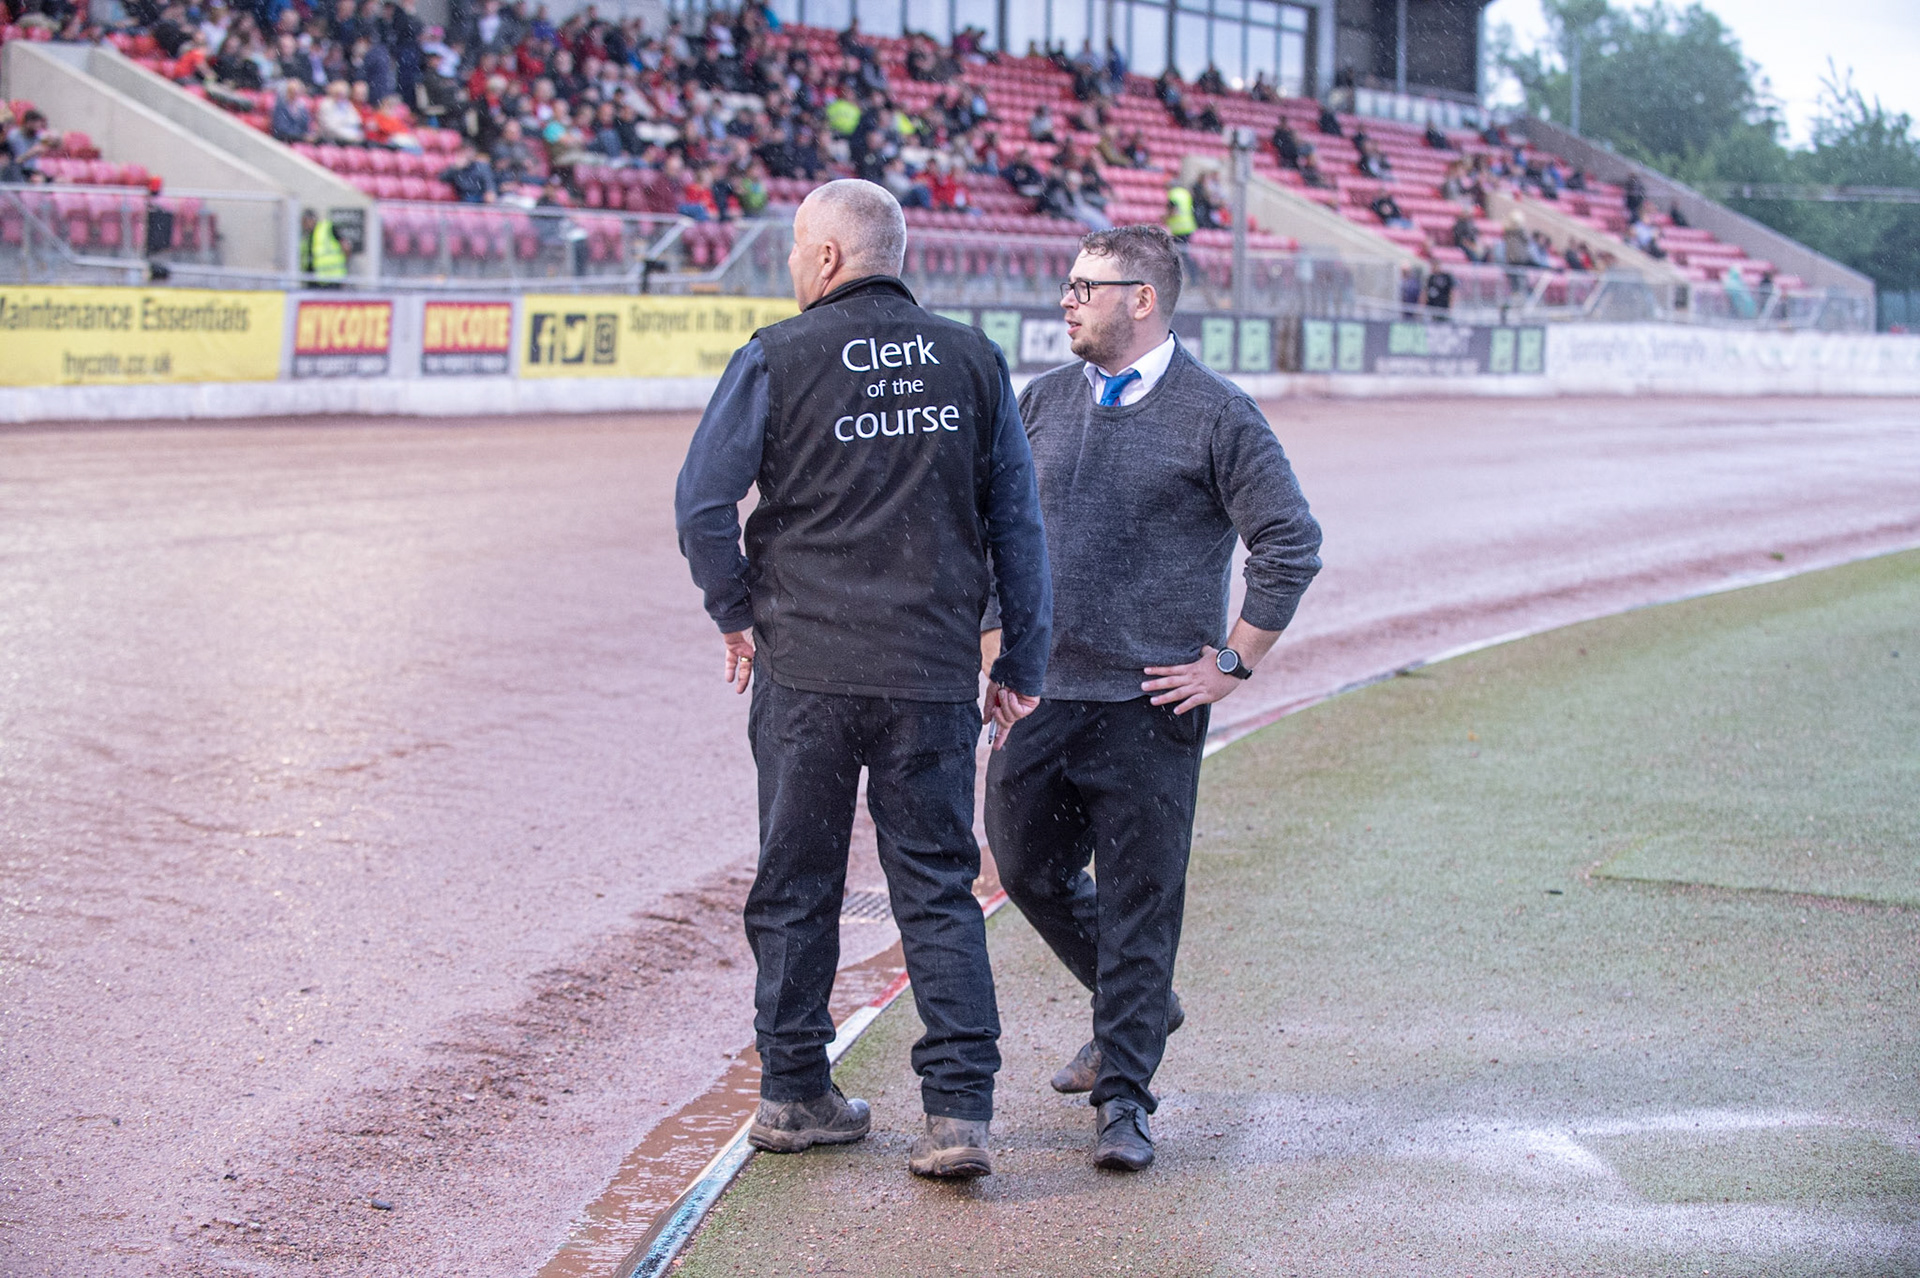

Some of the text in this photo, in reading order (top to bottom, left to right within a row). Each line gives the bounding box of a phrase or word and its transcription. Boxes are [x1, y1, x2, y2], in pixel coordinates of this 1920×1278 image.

[0, 296, 250, 332] aintenance Essentials
[297, 306, 389, 349] HYCOTE
[424, 306, 510, 349] HYCOTE
[841, 334, 940, 372] Clerk
[866, 378, 924, 398] of the
[834, 404, 960, 442] course
